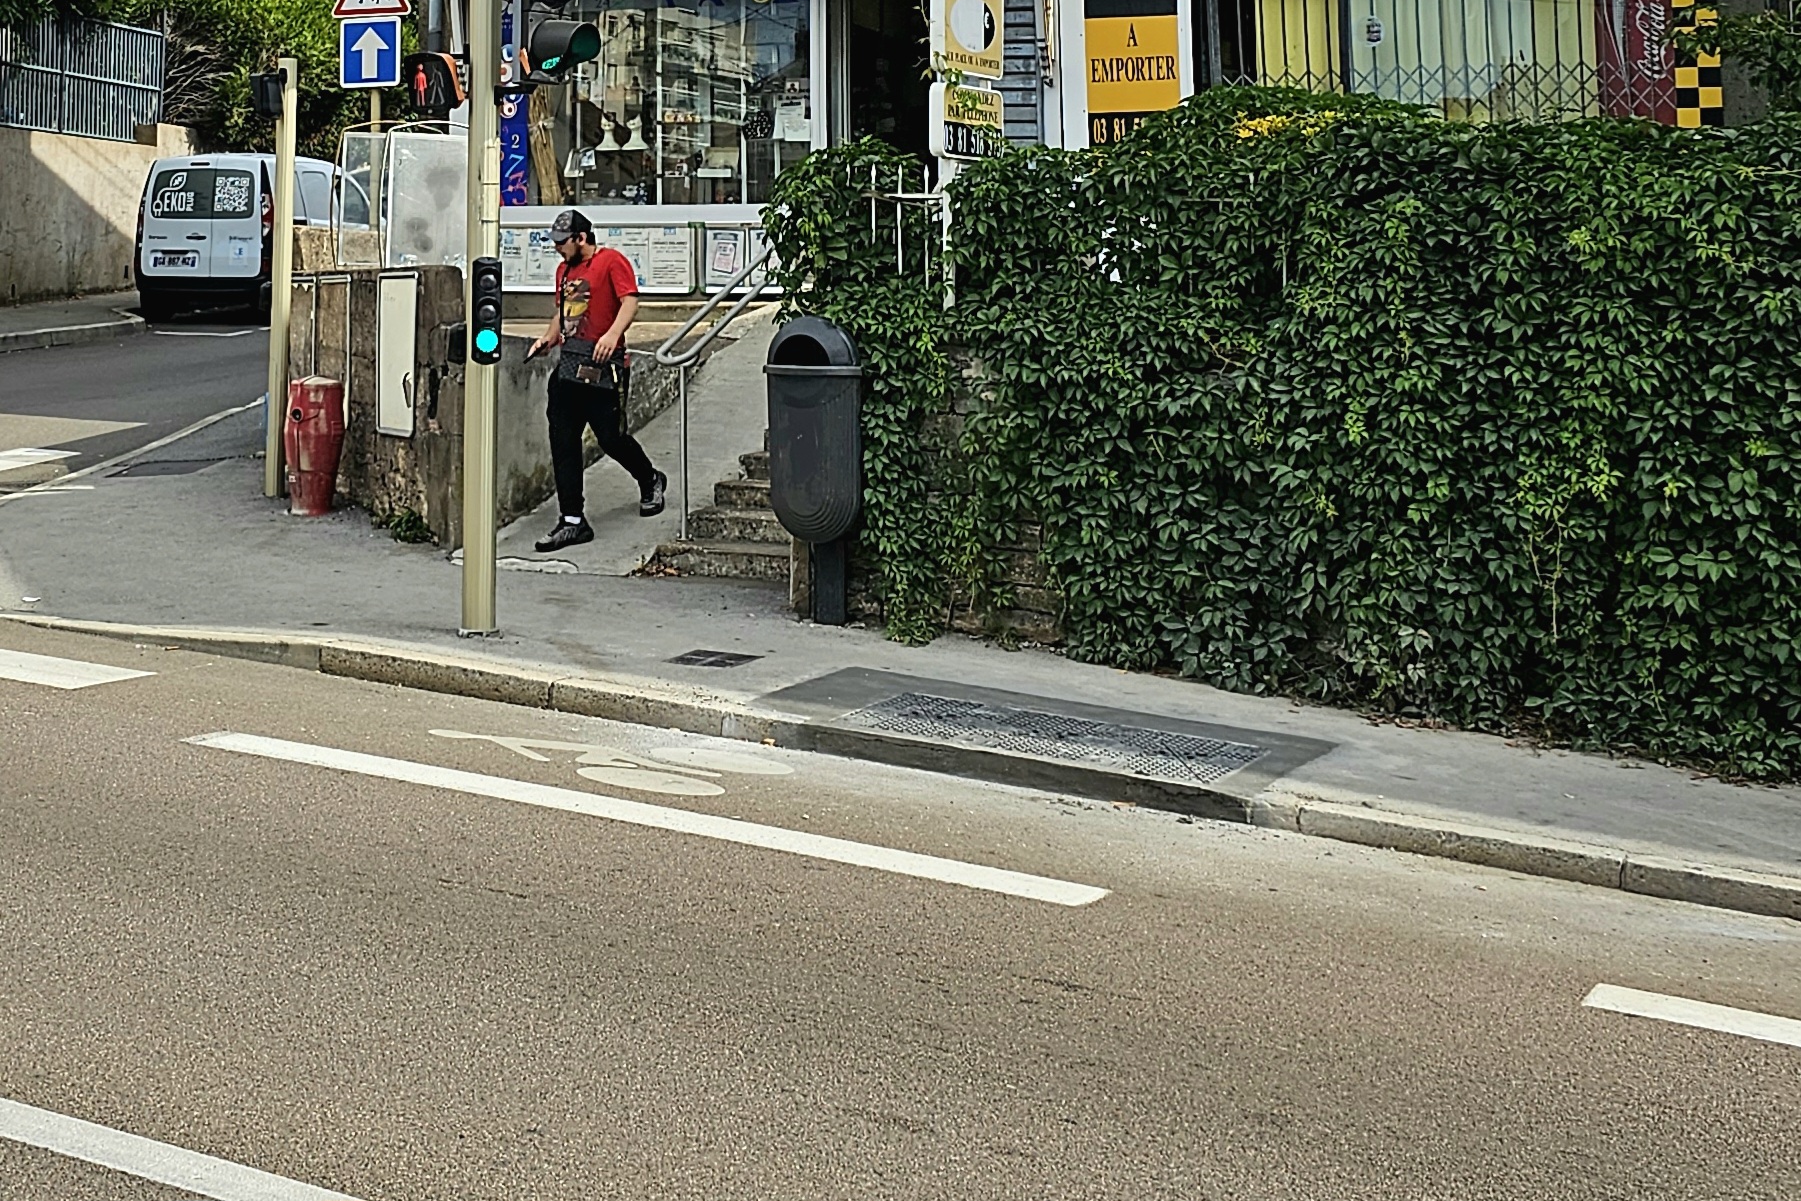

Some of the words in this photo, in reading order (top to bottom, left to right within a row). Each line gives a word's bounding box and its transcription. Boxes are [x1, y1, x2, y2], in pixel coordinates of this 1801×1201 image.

[1126, 22, 1139, 48] A
[1090, 55, 1177, 84] EMPORTER
[943, 124, 954, 151] 03
[957, 126, 967, 153] 81
[1093, 118, 1107, 144] 03
[1113, 117, 1126, 143] 81
[163, 191, 186, 212] EKO
[185, 191, 195, 212] PLUG
